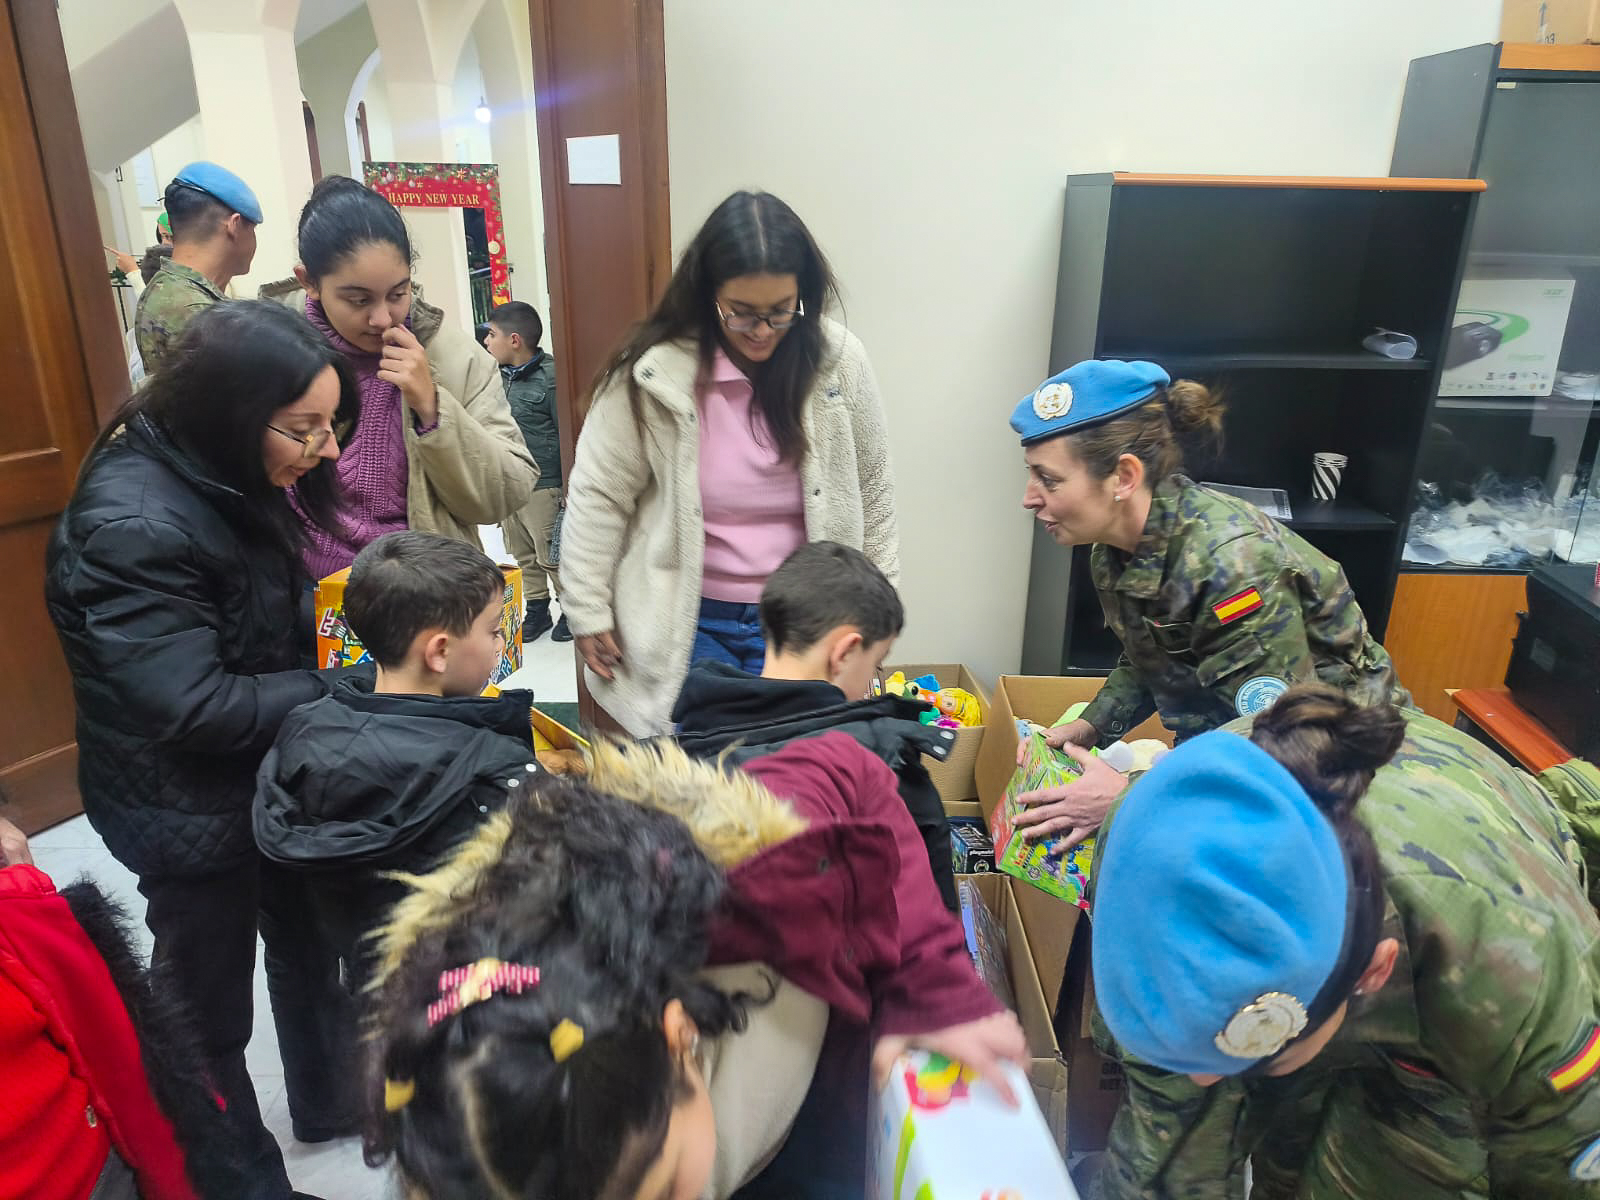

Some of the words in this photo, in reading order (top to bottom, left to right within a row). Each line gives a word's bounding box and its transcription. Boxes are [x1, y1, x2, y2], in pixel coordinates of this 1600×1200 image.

[388, 192, 422, 204] HAPPY
[425, 193, 448, 205] NEW
[451, 193, 480, 206] YEAR
